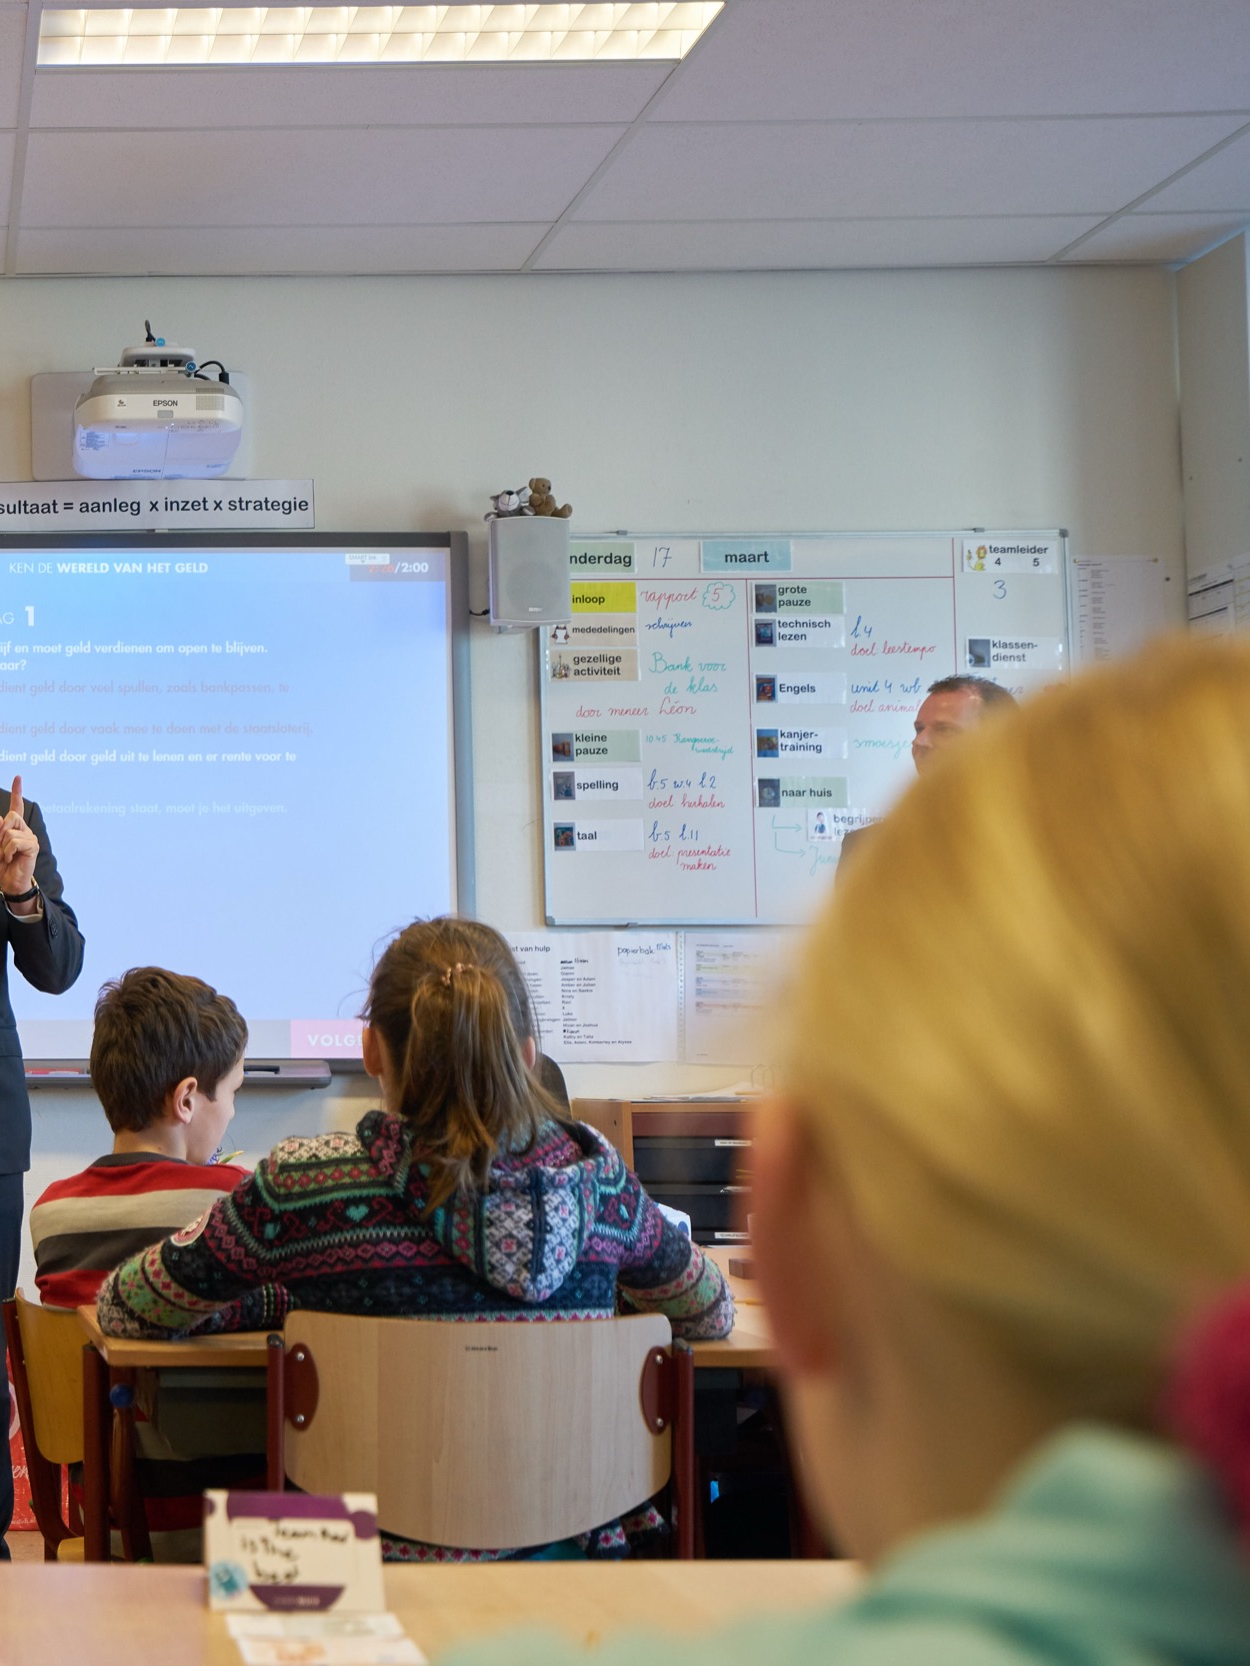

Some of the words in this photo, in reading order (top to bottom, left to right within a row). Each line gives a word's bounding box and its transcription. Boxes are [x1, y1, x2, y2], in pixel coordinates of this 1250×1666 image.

[152, 399, 179, 407] EPSON
[79, 498, 141, 516] aanleg
[149, 500, 159, 512] x
[164, 497, 210, 512] inzet
[213, 500, 223, 511] x
[228, 497, 309, 515] strategie
[989, 545, 1048, 555] teamleider
[652, 547, 672, 568] 17
[724, 551, 770, 563] maart
[994, 557, 1002, 566] 4
[1032, 557, 1040, 567] 5
[9, 563, 34, 573] KEN
[38, 563, 53, 573] DE
[57, 563, 109, 573] WERELD
[113, 563, 143, 573] VAN
[147, 563, 171, 573] HET
[175, 563, 208, 573] GELD
[778, 586, 807, 596] grote
[992, 579, 1007, 600] 3
[572, 595, 606, 605] inloop
[640, 587, 700, 610] rapport
[713, 588, 724, 603] 5
[778, 598, 811, 609] pauze
[25, 606, 35, 626] 1
[778, 619, 831, 629] technisch
[572, 625, 635, 635] mededelingen
[778, 632, 807, 641] lezen
[15, 643, 28, 653] en
[33, 642, 63, 653] moet
[65, 641, 91, 656] geld
[94, 641, 152, 653] verdienen
[156, 643, 175, 653] om
[178, 643, 208, 656] open
[211, 642, 222, 653] te
[226, 641, 268, 656] blijven.
[881, 640, 937, 661] leestempo
[992, 640, 1038, 650] klassen-
[573, 654, 622, 664] gezellige
[648, 652, 693, 674] Bank
[698, 660, 727, 672] voor
[992, 652, 1026, 663] dienst
[573, 666, 621, 676] activiteit
[30, 680, 55, 697] geld
[59, 680, 86, 693] door
[664, 682, 678, 694] de
[686, 677, 718, 695] klas
[779, 684, 816, 694] Engels
[851, 680, 881, 694] unit
[885, 680, 893, 693] 4
[576, 705, 602, 718] door
[607, 705, 650, 717] meneer
[30, 721, 55, 737] geld
[59, 721, 86, 734] door
[574, 733, 607, 742] kleine
[780, 730, 818, 740] kanjer-
[575, 747, 608, 757] pauze
[780, 742, 822, 753] training
[30, 749, 56, 766] geld
[59, 749, 87, 762] door
[91, 749, 116, 766] geld
[120, 750, 135, 762] uit
[138, 751, 149, 762] te
[153, 749, 184, 762] lenen
[188, 752, 202, 762] en
[206, 752, 217, 762] er
[222, 751, 252, 762] rente
[255, 752, 282, 762] voor
[285, 751, 296, 762] te
[576, 780, 619, 791] spelling
[781, 788, 807, 797] naar
[810, 788, 833, 797] huis
[680, 794, 725, 808] herhalen
[166, 803, 195, 813] moet
[577, 831, 597, 840] taal
[676, 848, 731, 865] presentatie
[680, 860, 717, 871] maken
[534, 945, 551, 953] hulp
